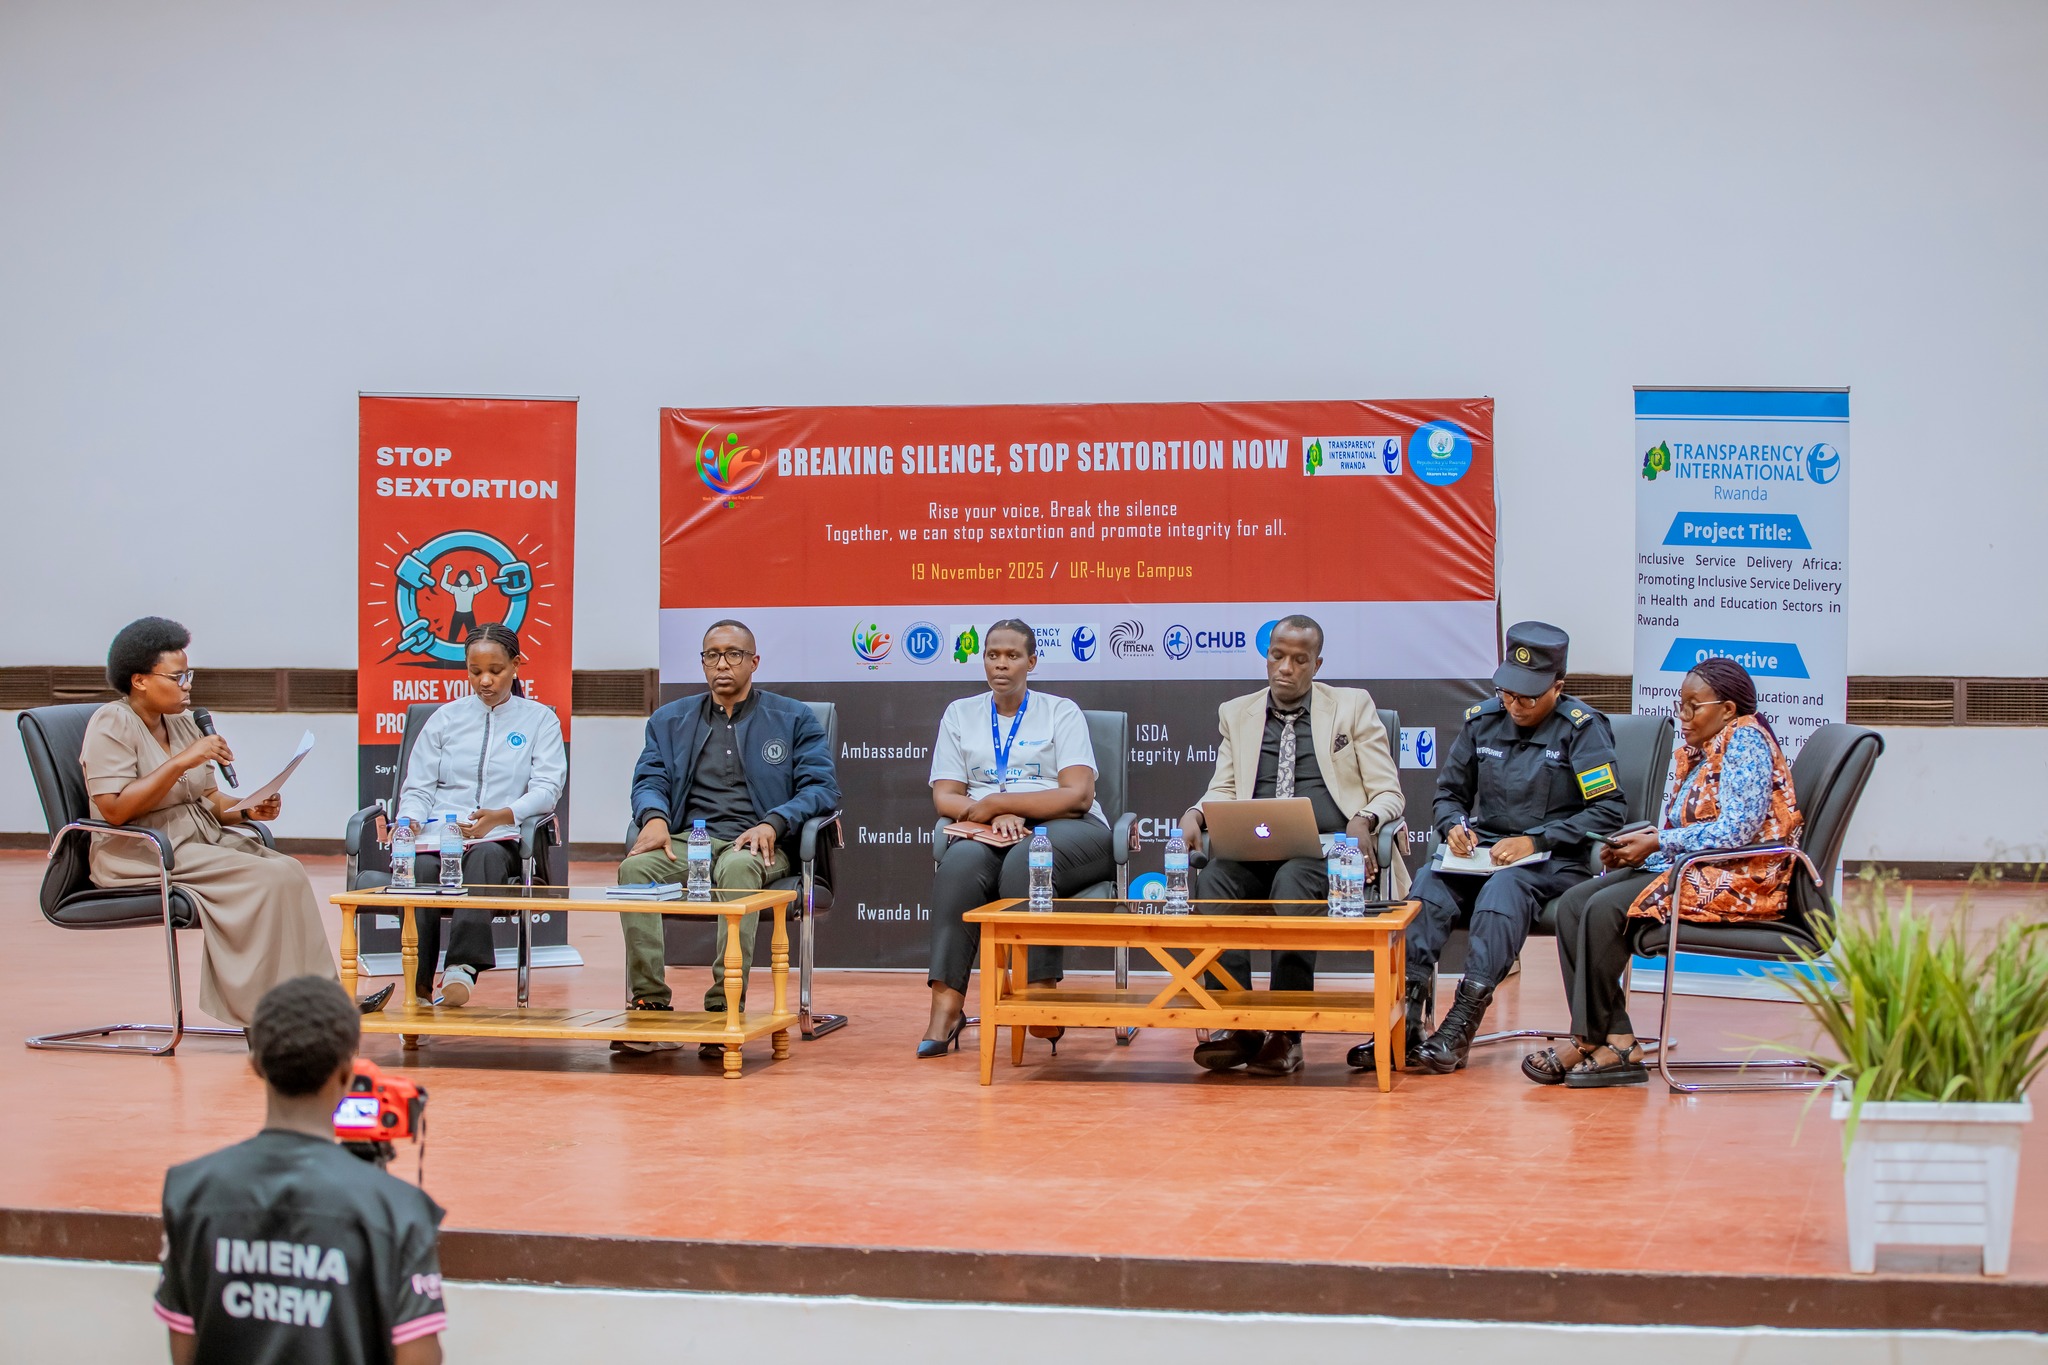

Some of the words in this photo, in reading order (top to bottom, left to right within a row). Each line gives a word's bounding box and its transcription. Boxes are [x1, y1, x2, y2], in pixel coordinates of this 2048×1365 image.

[1328, 441, 1376, 449] TRANSPARENCY
[1674, 443, 1804, 462] TRANSPARENCY
[376, 446, 452, 467] STOP
[778, 445, 893, 477] BREAKING
[902, 443, 1001, 477] SILENCE,
[1009, 442, 1068, 473] STOP
[1077, 439, 1224, 472] SEXTORTION
[1232, 439, 1289, 470] NOW
[1329, 451, 1377, 460] INTERNATIONAL
[1340, 461, 1366, 470] RWANDA
[1675, 463, 1804, 481] INTERNATIONAL
[376, 477, 559, 499] SEXTORTION
[1714, 485, 1768, 501] Rwanda
[929, 502, 958, 519] Rise
[965, 505, 997, 522] your
[1050, 501, 1091, 518] Break
[1098, 500, 1120, 517] the
[1126, 499, 1178, 517] silence
[826, 524, 893, 544] Together,
[898, 528, 917, 541] we
[923, 527, 948, 541] can
[954, 525, 984, 543] stop
[990, 523, 1064, 540] sextortion
[1070, 521, 1095, 539] and
[1101, 523, 1162, 541] promote
[1168, 520, 1231, 540] integrity
[1237, 520, 1259, 537] for
[1265, 519, 1287, 536] all.
[1683, 521, 1745, 544] Project
[1749, 523, 1792, 541] Title:
[911, 562, 925, 580] 19
[931, 562, 1002, 580] November
[1008, 561, 1044, 580] 2025
[1070, 561, 1131, 581] UR-Huye
[1137, 560, 1193, 580] Campus
[1638, 552, 1685, 566] Inclusive
[1695, 554, 1736, 567] Service
[1747, 556, 1793, 572] Delivery
[1802, 557, 1842, 571] Africa:
[1638, 573, 1695, 590] Promoting
[1697, 575, 1747, 589] Inclusive
[1750, 576, 1790, 590] Service
[1793, 579, 1842, 595] Delivery
[1637, 593, 1646, 605] in
[1650, 594, 1688, 607] Health
[1693, 596, 1715, 608] and
[1720, 597, 1777, 610] Education
[1782, 599, 1823, 612] Sectors
[1829, 600, 1841, 613] in
[1637, 614, 1680, 627] Rwanda
[1195, 631, 1246, 649] CHUB
[393, 680, 440, 701] RAISE
[1757, 691, 1799, 704] ucation
[1802, 693, 1824, 706] and
[1136, 724, 1169, 742] ISDA
[841, 741, 928, 760] Ambassador
[1128, 745, 1181, 766] tegrity
[375, 765, 391, 775] Say
[858, 826, 912, 844] Rwanda
[857, 903, 911, 921] Rwanda
[215, 1237, 350, 1286] IMENA
[221, 1280, 332, 1329] CREW
